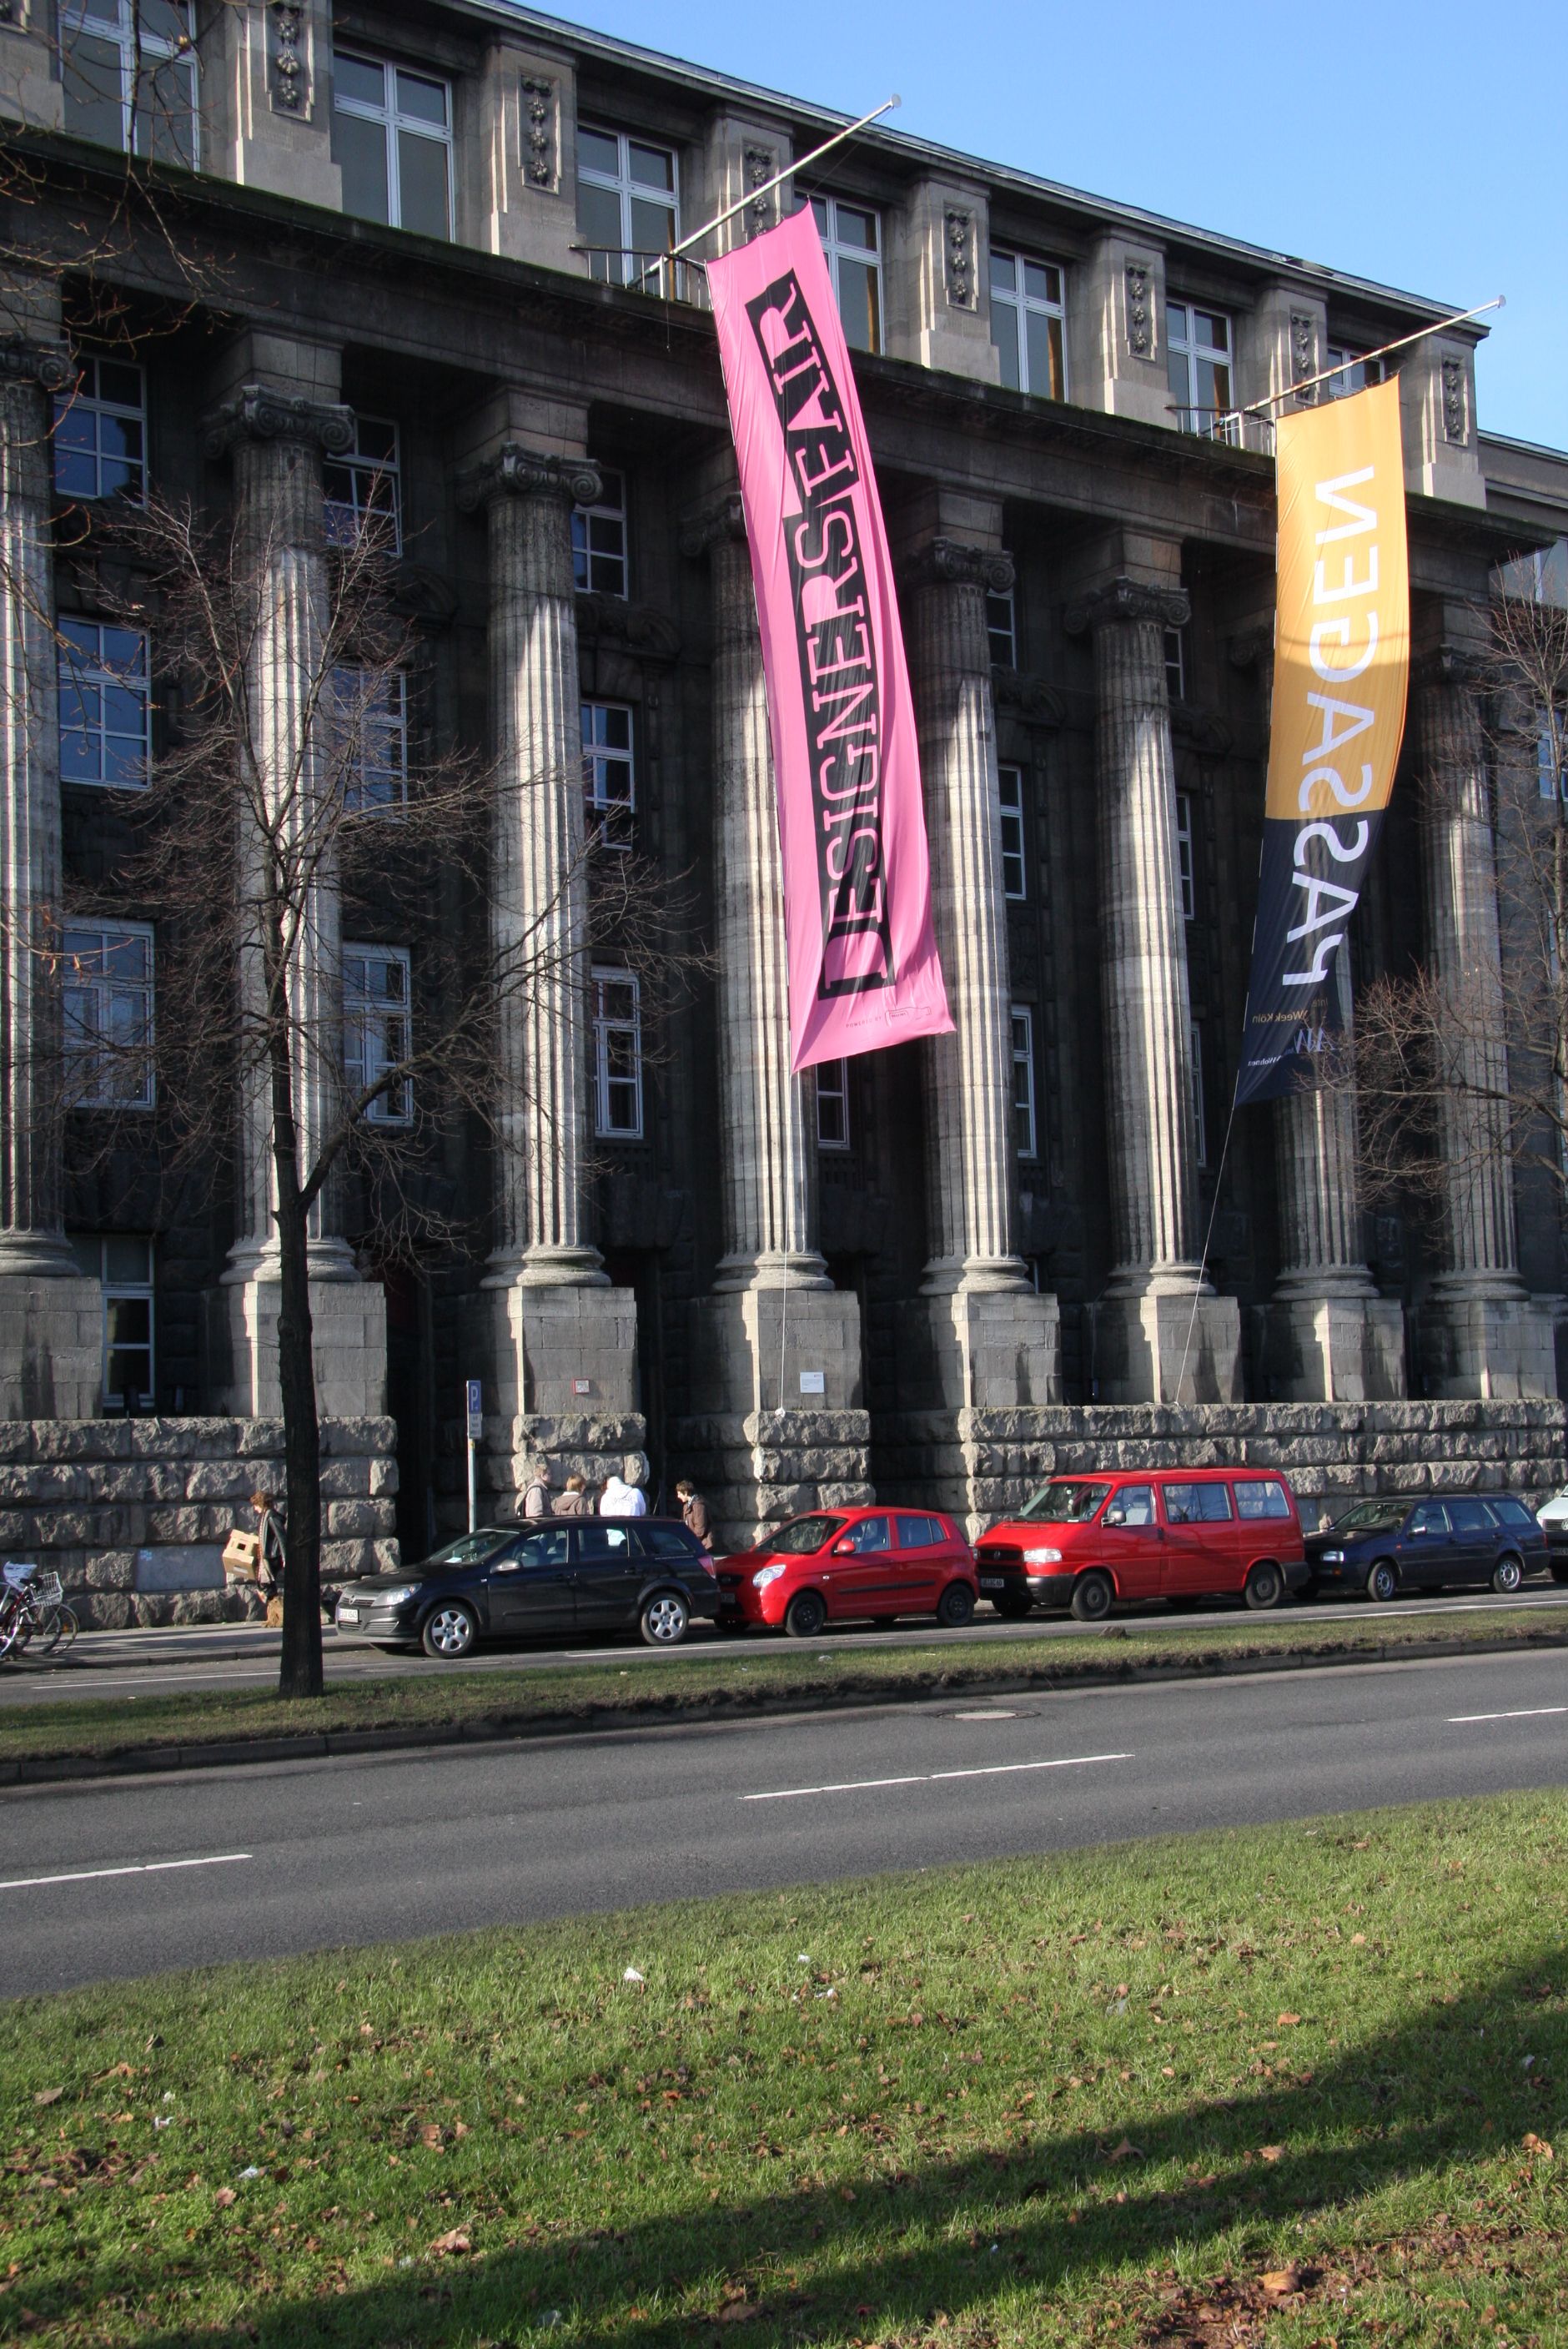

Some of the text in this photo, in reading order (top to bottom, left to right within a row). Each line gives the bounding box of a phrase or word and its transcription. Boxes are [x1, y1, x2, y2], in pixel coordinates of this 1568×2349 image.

[759, 282, 889, 990] DESIGNERS FAIR
[470, 1385, 479, 1411] P
